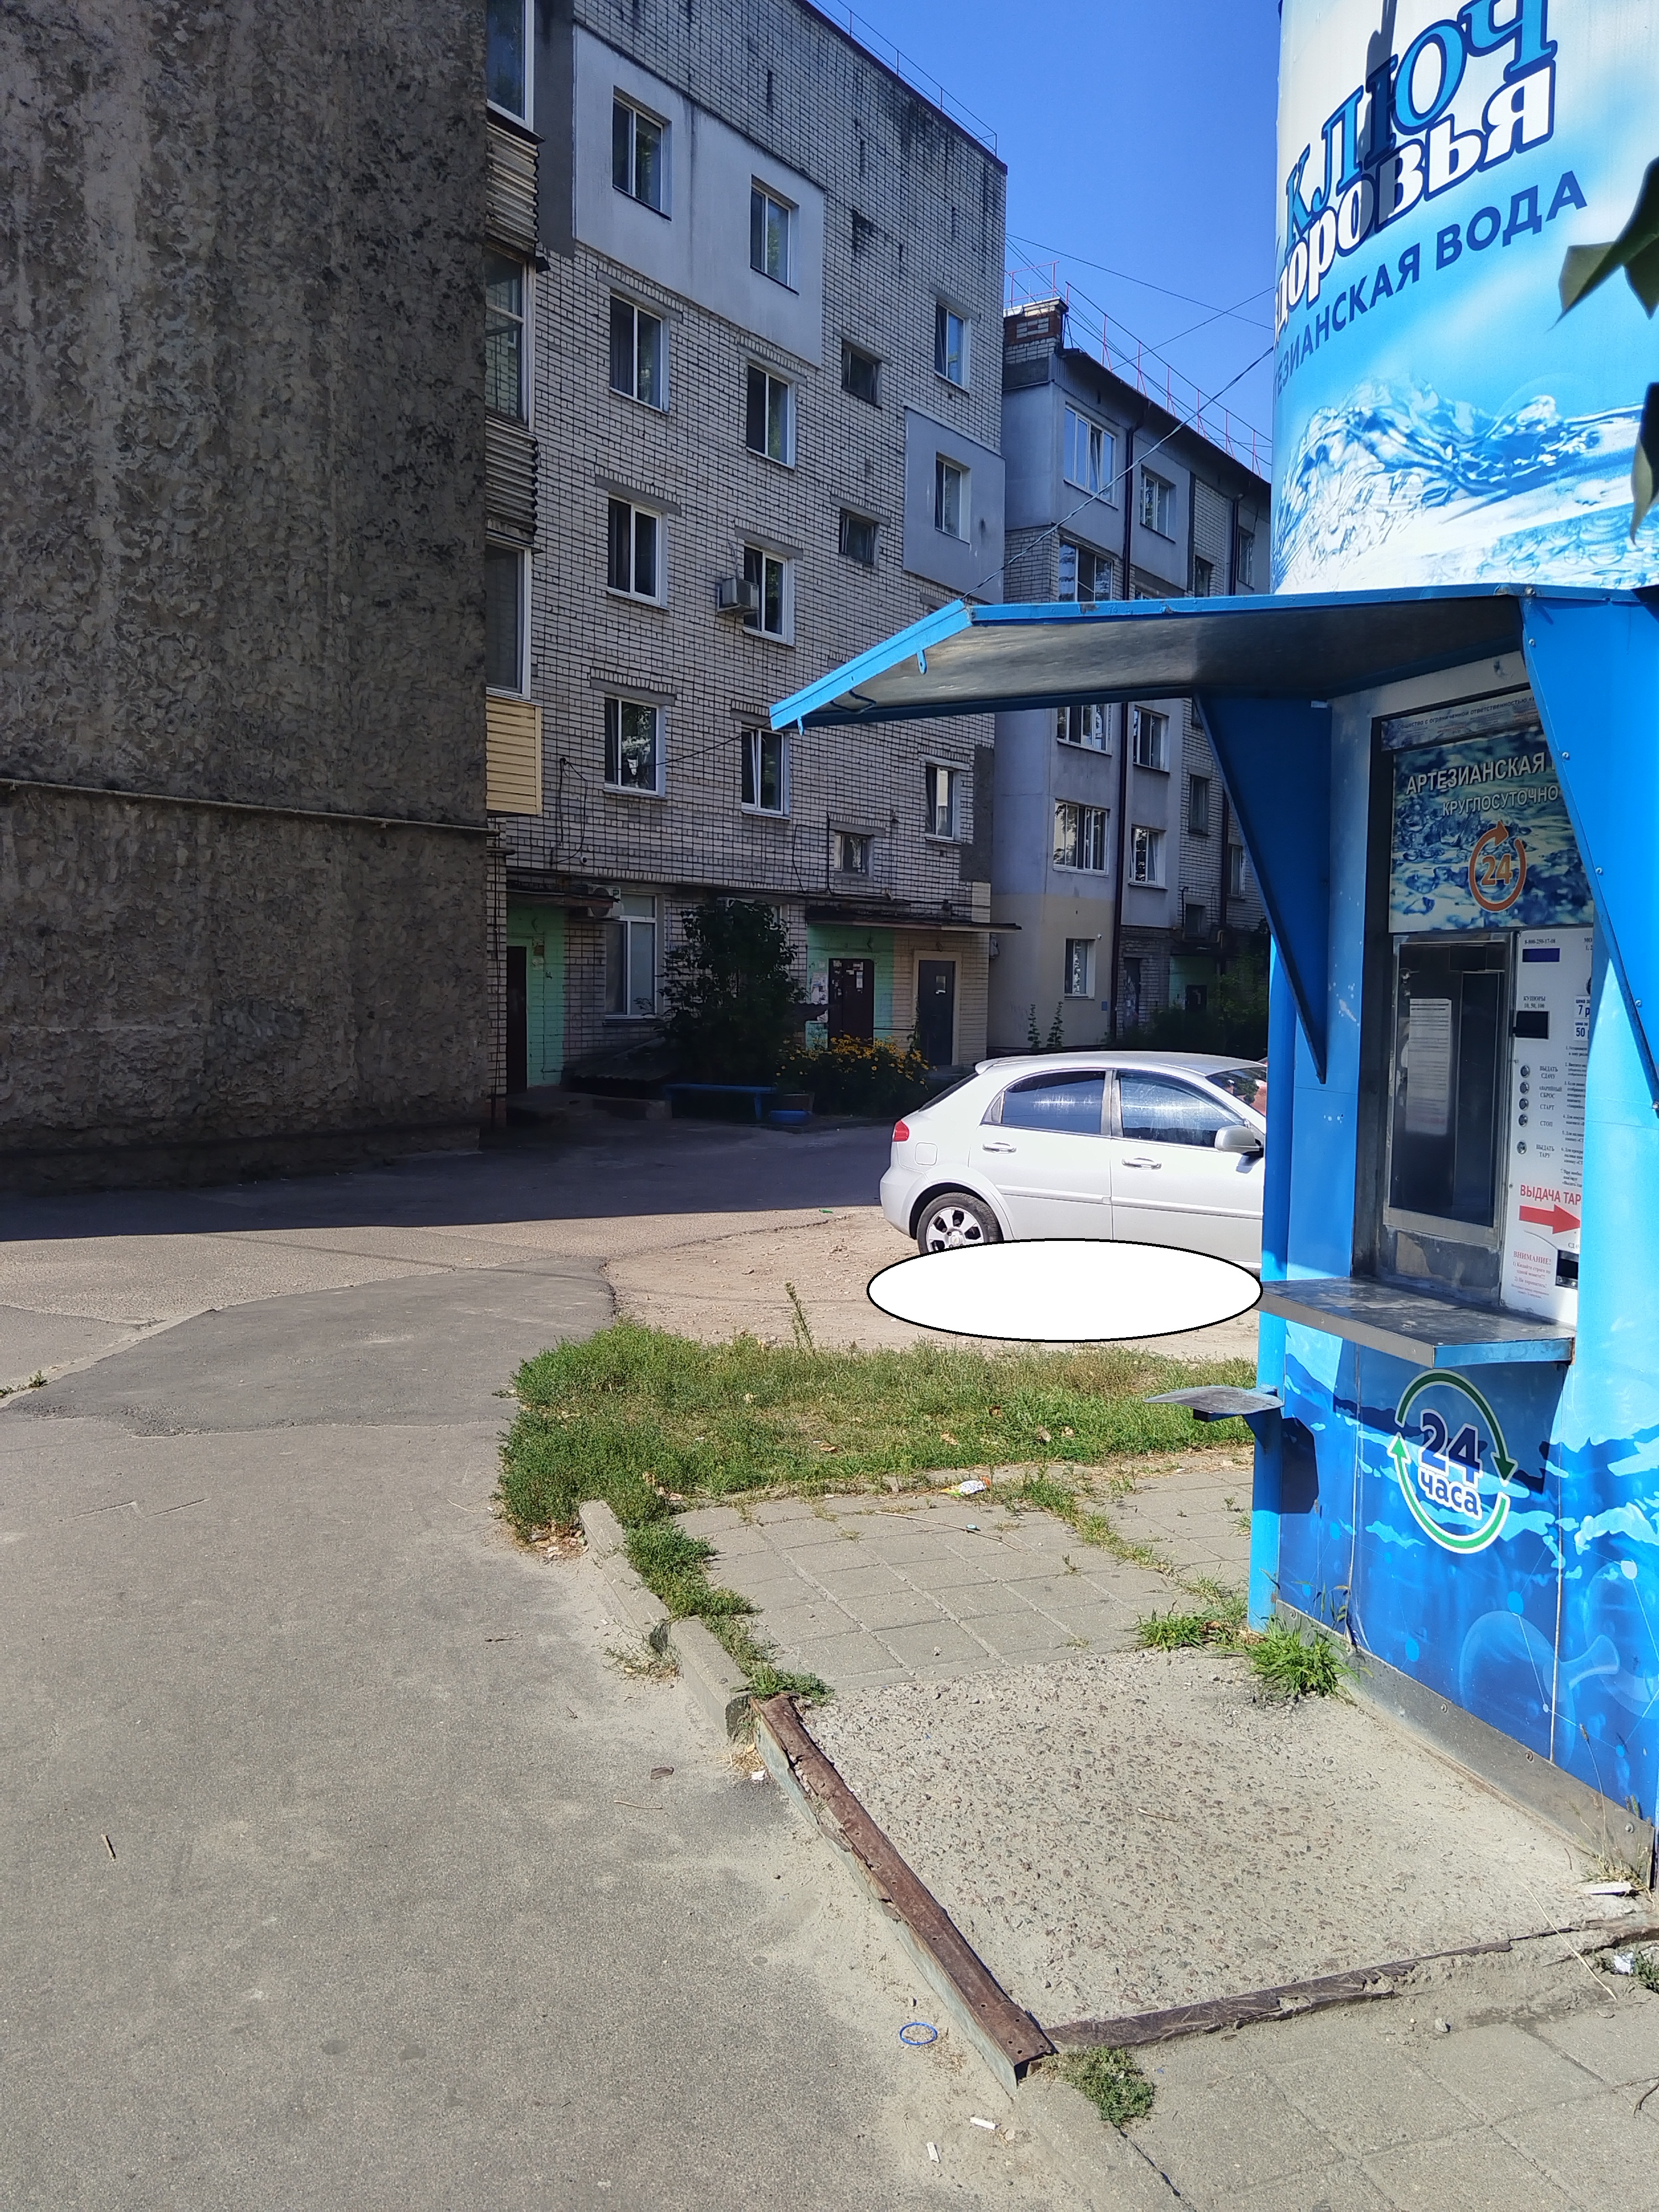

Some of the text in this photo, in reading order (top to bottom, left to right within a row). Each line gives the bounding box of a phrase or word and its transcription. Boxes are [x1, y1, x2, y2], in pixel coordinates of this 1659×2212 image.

[1285, 0, 1558, 262] КЛЮЧ
[1436, 170, 1587, 271] ВОДА
[1406, 752, 1546, 795] АРТЕЗИАНСКАЯ
[1442, 785, 1558, 816] КРУГЛОСУТОЧНО
[1480, 853, 1513, 886] 24
[1578, 1005, 1583, 1015] 7
[1576, 1027, 1585, 1037] 50
[1520, 1185, 1582, 1206] ВЫДАЧА ТАР
[1514, 1251, 1552, 1265] ВНИМАНИЕ!
[1419, 1409, 1483, 1488] 24
[1419, 1468, 1480, 1519] часа
